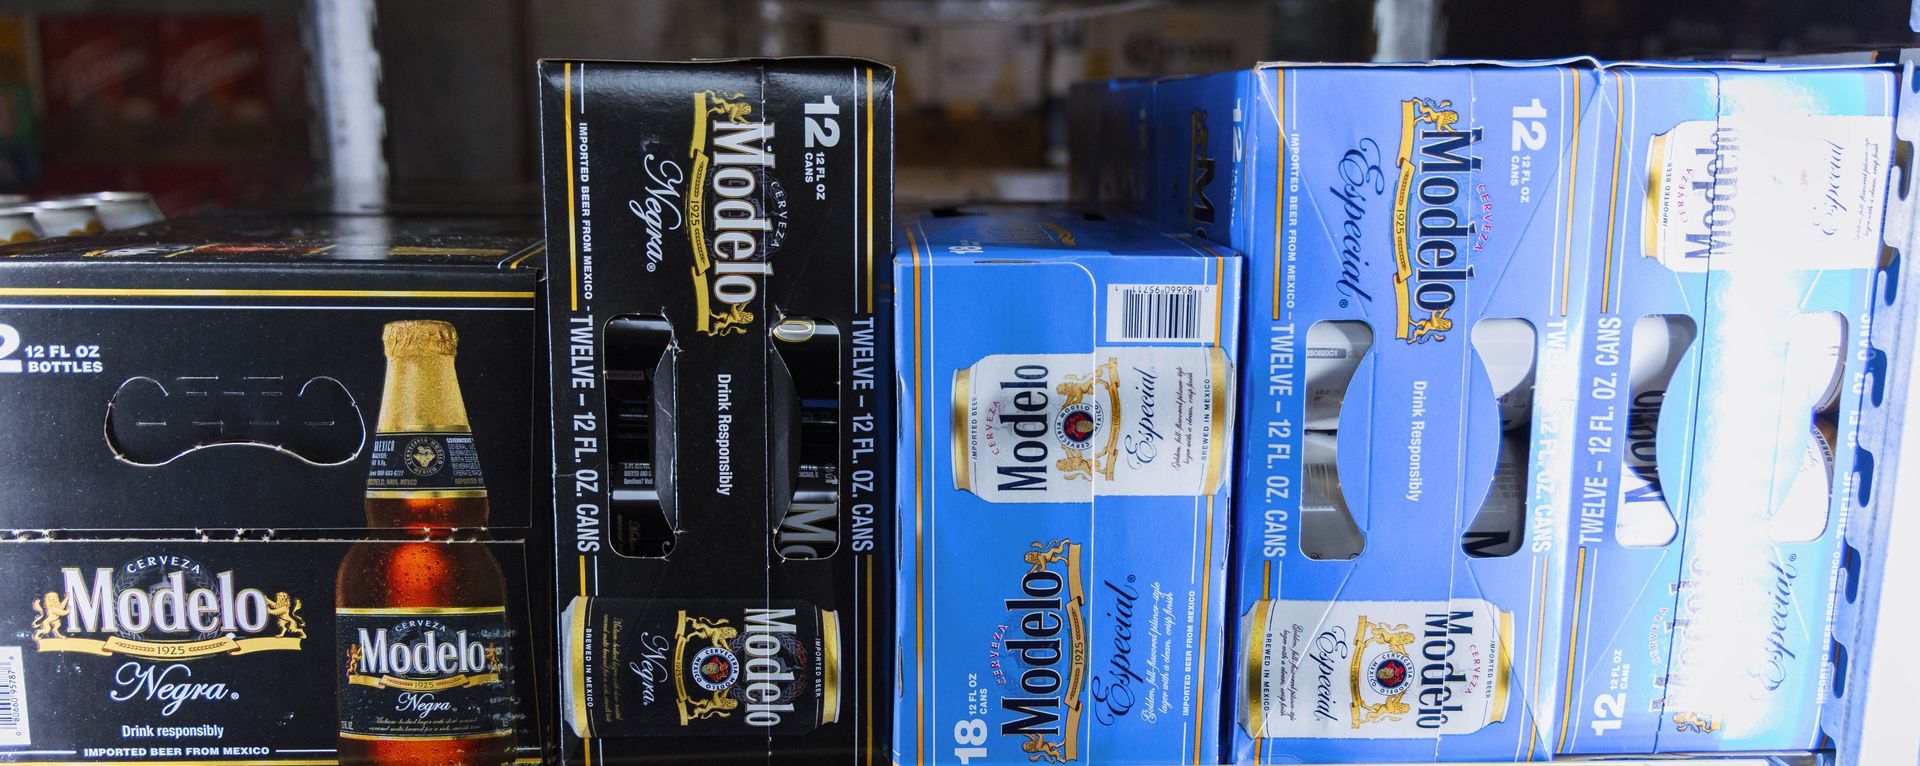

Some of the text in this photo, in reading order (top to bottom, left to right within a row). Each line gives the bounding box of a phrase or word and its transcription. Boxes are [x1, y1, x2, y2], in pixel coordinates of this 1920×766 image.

[804, 95, 840, 148] 12
[1511, 98, 1547, 151] 12
[805, 153, 813, 183] CANS
[816, 152, 825, 200] 12 FL OZ
[1511, 156, 1520, 187] CANS
[1521, 155, 1531, 204] 12 FL OZ
[579, 122, 593, 300] IMPORTED BEER FROM MEXICO
[690, 201, 700, 226] 1925
[712, 120, 775, 304] Modelo
[770, 181, 787, 249] CERVEZA
[1473, 183, 1493, 251] CERVEZA
[1663, 183, 1671, 227] IMPORTED
[1677, 168, 1694, 223] CERVEZA
[1287, 133, 1300, 309] IMPORTED BEER FROM MEXICO
[1330, 137, 1386, 301] Especial
[1396, 208, 1406, 236] 1925
[1415, 127, 1484, 312] Modelo
[25, 345, 100, 358] 12 FL OZ
[28, 361, 104, 373] BOTTLES
[570, 315, 600, 553] TWELVE 12 FL. OZ. CANS
[717, 374, 733, 496] Drink Responsibly
[852, 317, 874, 552] TWELVE 12 FL. OZ. CANS
[986, 400, 1001, 455] CERVEZA
[997, 365, 1049, 492] Modelo
[1057, 405, 1090, 449] CERVECERIA MODELO
[1125, 367, 1163, 471] Especial
[1204, 413, 1210, 423] IN
[1579, 317, 1622, 544] TWELVE 12 FL. OZ. CANS
[1183, 449, 1193, 465] lager
[1201, 426, 1209, 461] BREWED
[1263, 324, 1294, 559] TWELVE 12 FL. OZ. CANS
[1406, 380, 1427, 503] Drink Responsibly
[1532, 471, 1554, 553] OZ. CANS
[126, 556, 200, 574] CERVEZA
[62, 568, 268, 632] Modelo
[1163, 592, 1176, 618] finish
[1187, 590, 1195, 622] MEXICO
[395, 620, 446, 632] CERVEZA
[1163, 616, 1176, 636] crisp
[1186, 625, 1194, 649] FROM
[1649, 607, 1669, 665] CERVEZA
[1816, 552, 1840, 705] IMPORTED BEER FROM MEXICO
[157, 646, 185, 655] 1925
[358, 628, 487, 674] Modelo
[693, 656, 703, 683] MEXICO
[744, 608, 797, 727] Modelo
[990, 624, 1008, 685] CERVEZA
[1001, 570, 1064, 737] Modelo
[1074, 642, 1084, 665] 1925
[1091, 580, 1144, 727] Especial
[1141, 582, 1164, 724] Golden, full-flavored pilsner-style
[1161, 639, 1172, 663] clean,
[1264, 633, 1273, 672] BREWED
[1382, 653, 1413, 683] CERVECERIA
[1416, 610, 1474, 730] Modelo
[1465, 644, 1482, 695] CERVEZA
[1487, 640, 1497, 680] IMPORTED
[1610, 649, 1622, 690] 12 FL OZ
[414, 681, 434, 689] 1925
[969, 673, 977, 716] 12 FL OZ
[1159, 673, 1170, 690] with
[1182, 674, 1191, 716] IMPORTED
[1310, 625, 1349, 722] Especial
[1369, 661, 1378, 687] MEXICO
[1620, 664, 1631, 690] CANS
[979, 687, 988, 715] CANS
[1158, 691, 1173, 714] lager
[1591, 692, 1627, 736] 12
[84, 747, 269, 757] IMPORTED BEER FROM MEXICO
[123, 725, 224, 740] Drink responsibly
[954, 718, 988, 765] 18
